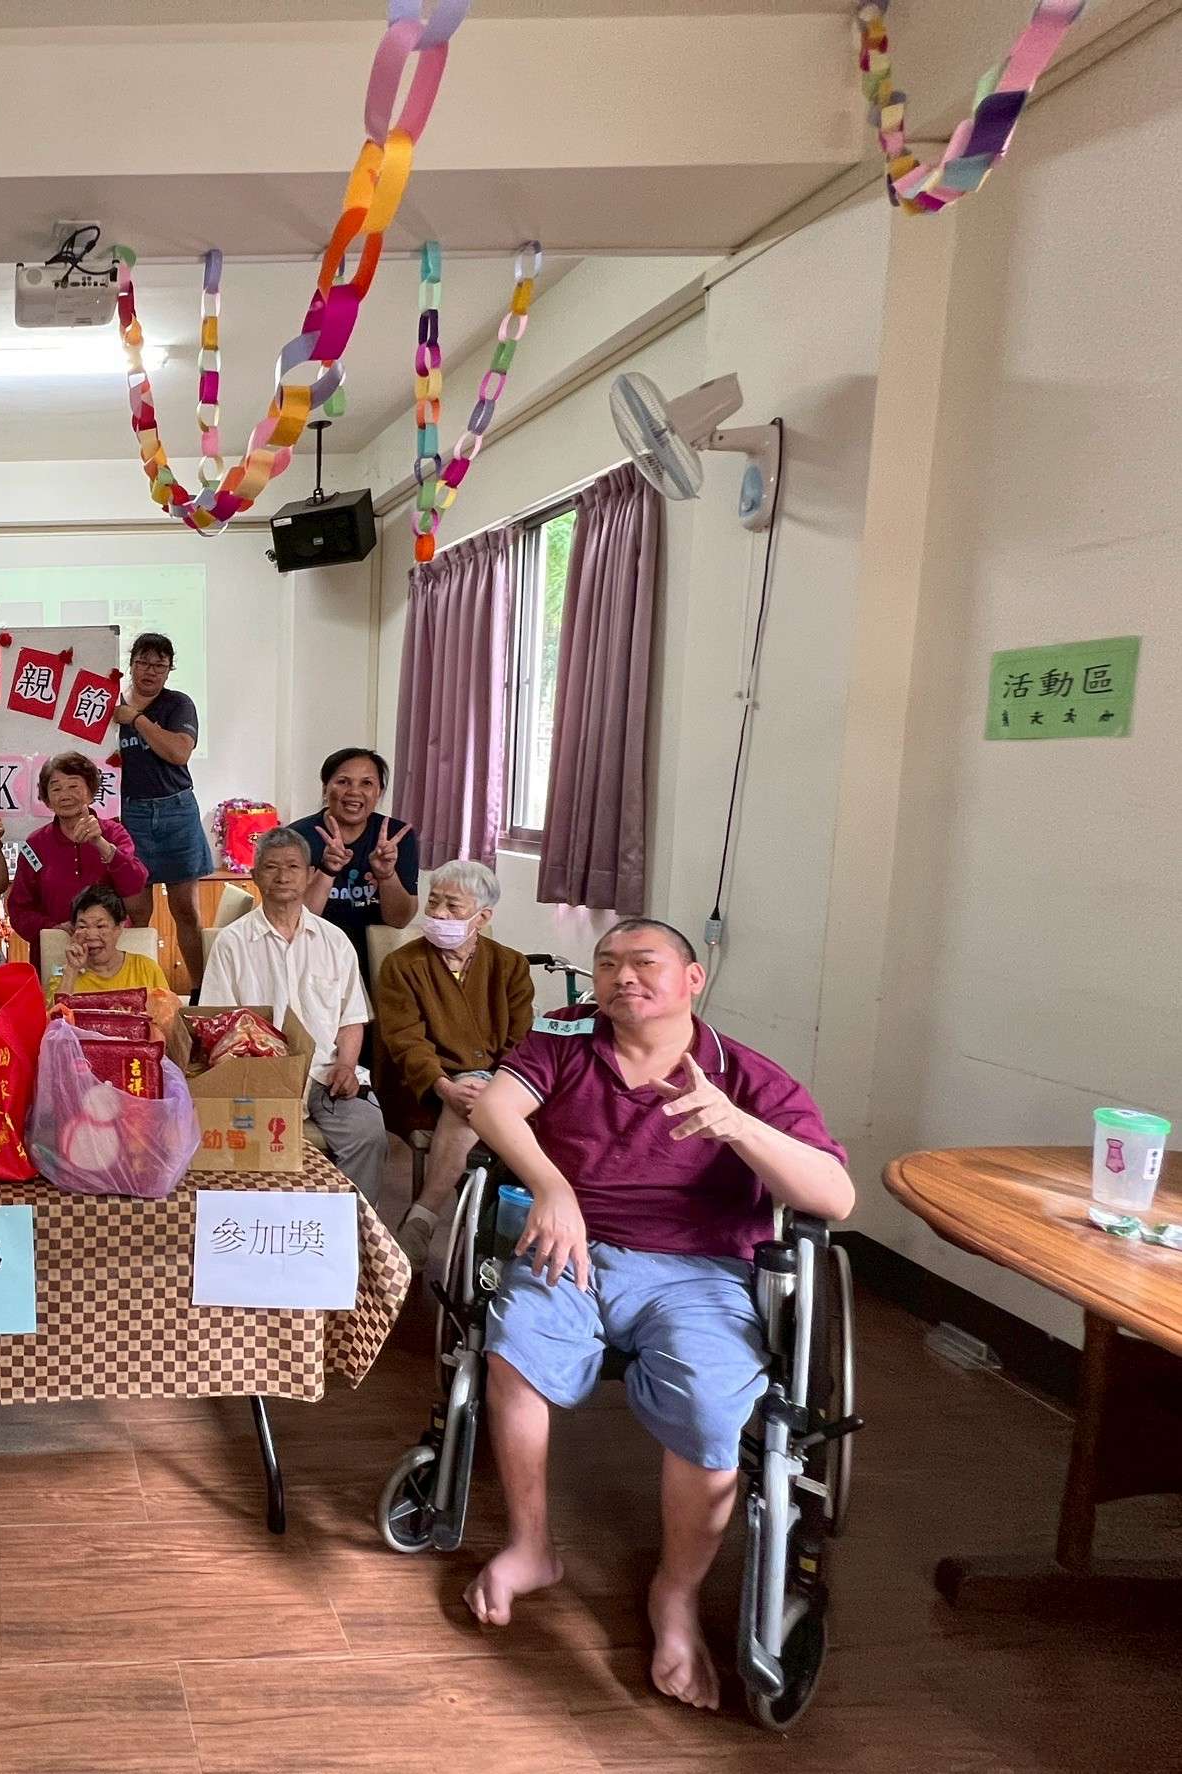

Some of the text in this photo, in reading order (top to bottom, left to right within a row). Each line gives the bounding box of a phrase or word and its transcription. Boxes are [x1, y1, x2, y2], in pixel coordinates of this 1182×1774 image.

[1003, 664, 1114, 698] 活動區
[128, 1058, 145, 1097] 吉祥
[269, 1144, 284, 1152] UP
[210, 1217, 325, 1257] 參加獎
